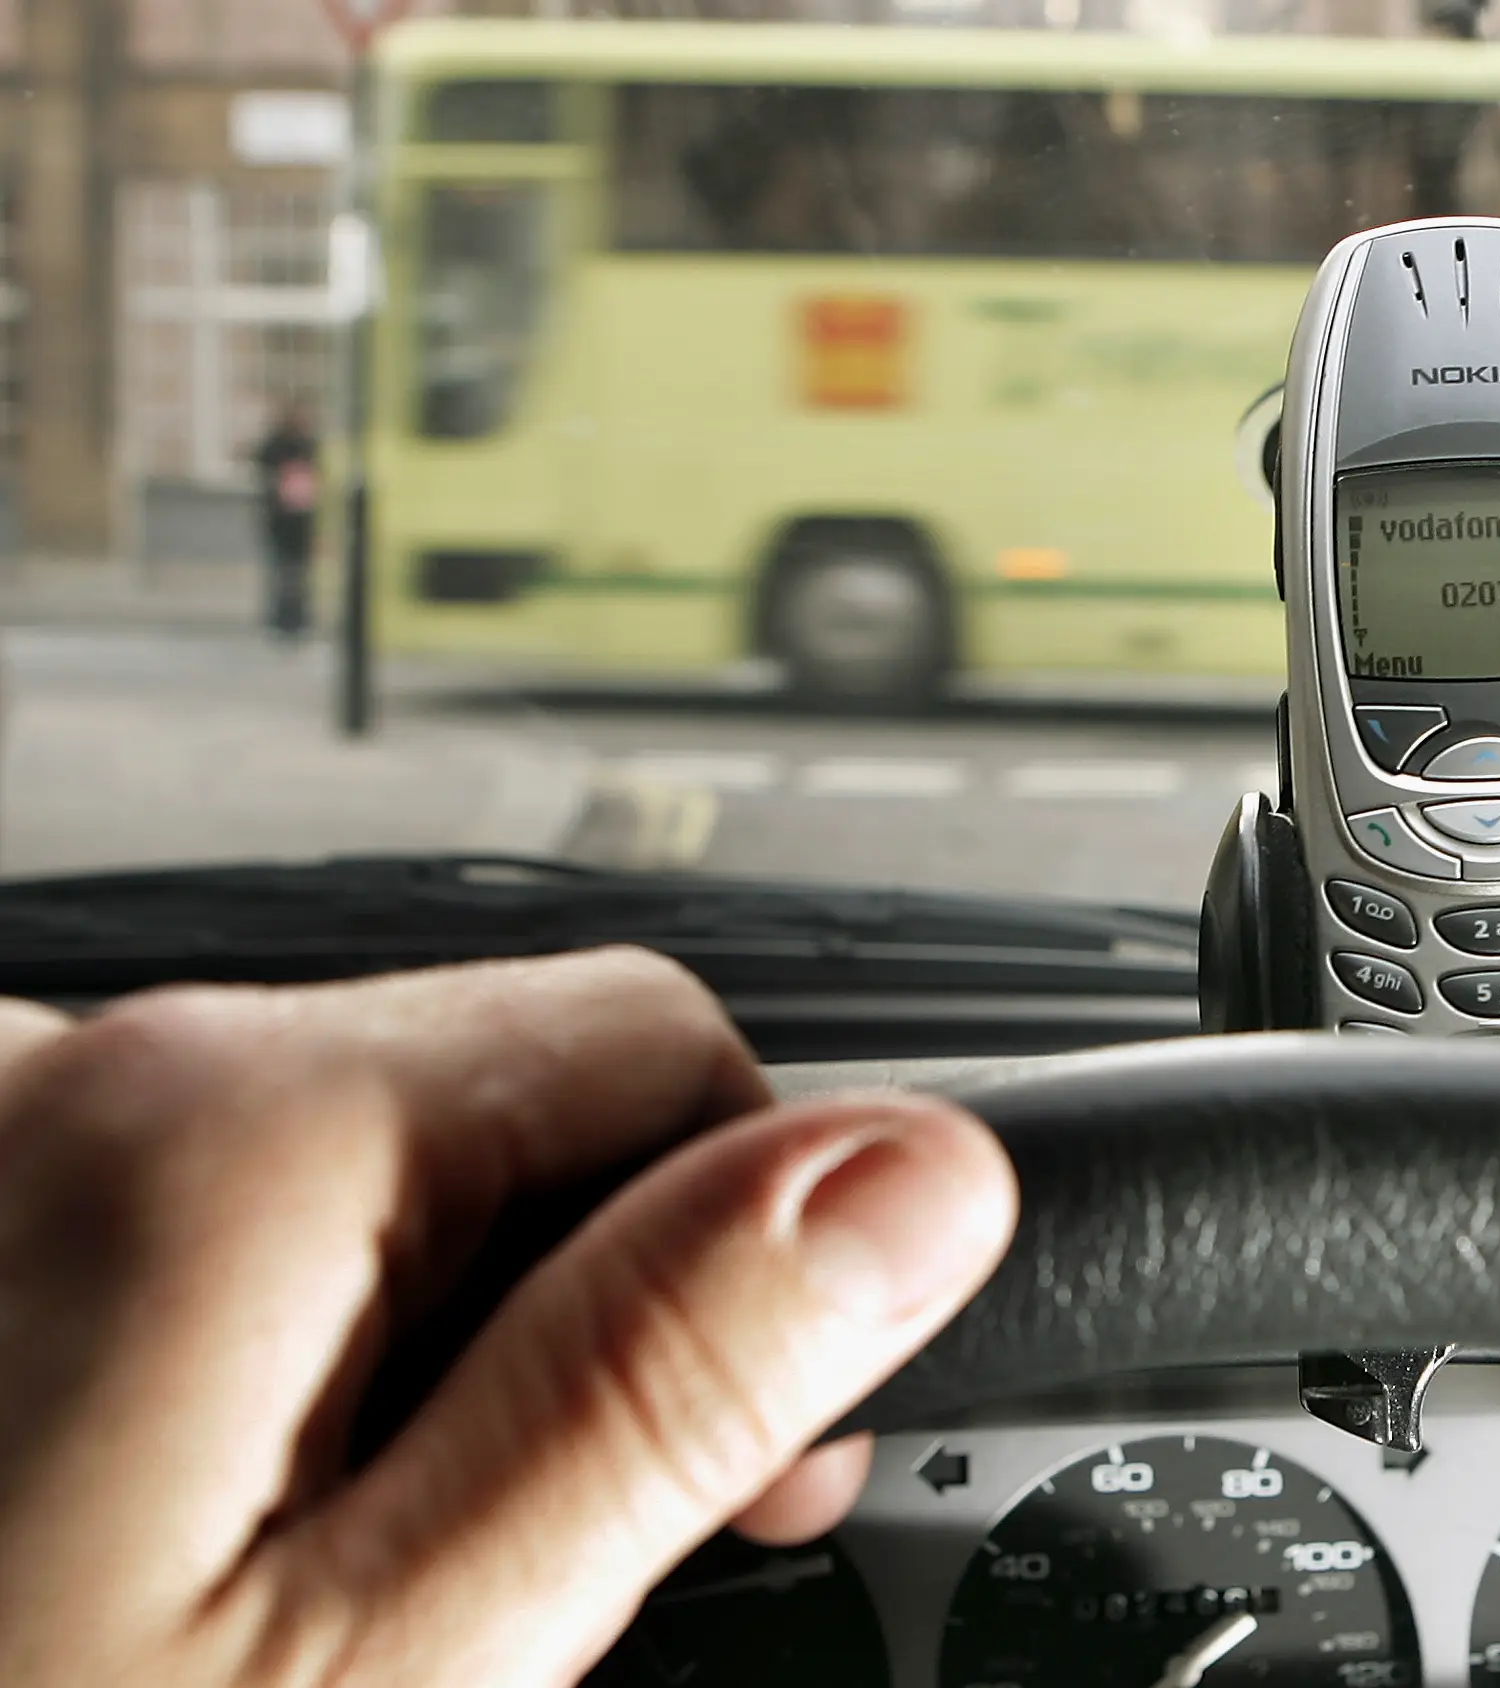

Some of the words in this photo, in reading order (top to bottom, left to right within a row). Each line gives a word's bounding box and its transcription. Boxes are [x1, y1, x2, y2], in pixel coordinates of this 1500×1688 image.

[1354, 652, 1423, 677] Menu
[1474, 920, 1490, 939] 2
[1477, 983, 1492, 1001] 5
[1092, 1462, 1154, 1493] 60
[1222, 1467, 1283, 1498] 80
[990, 1552, 1050, 1581] 40
[1284, 1541, 1366, 1571] 100
